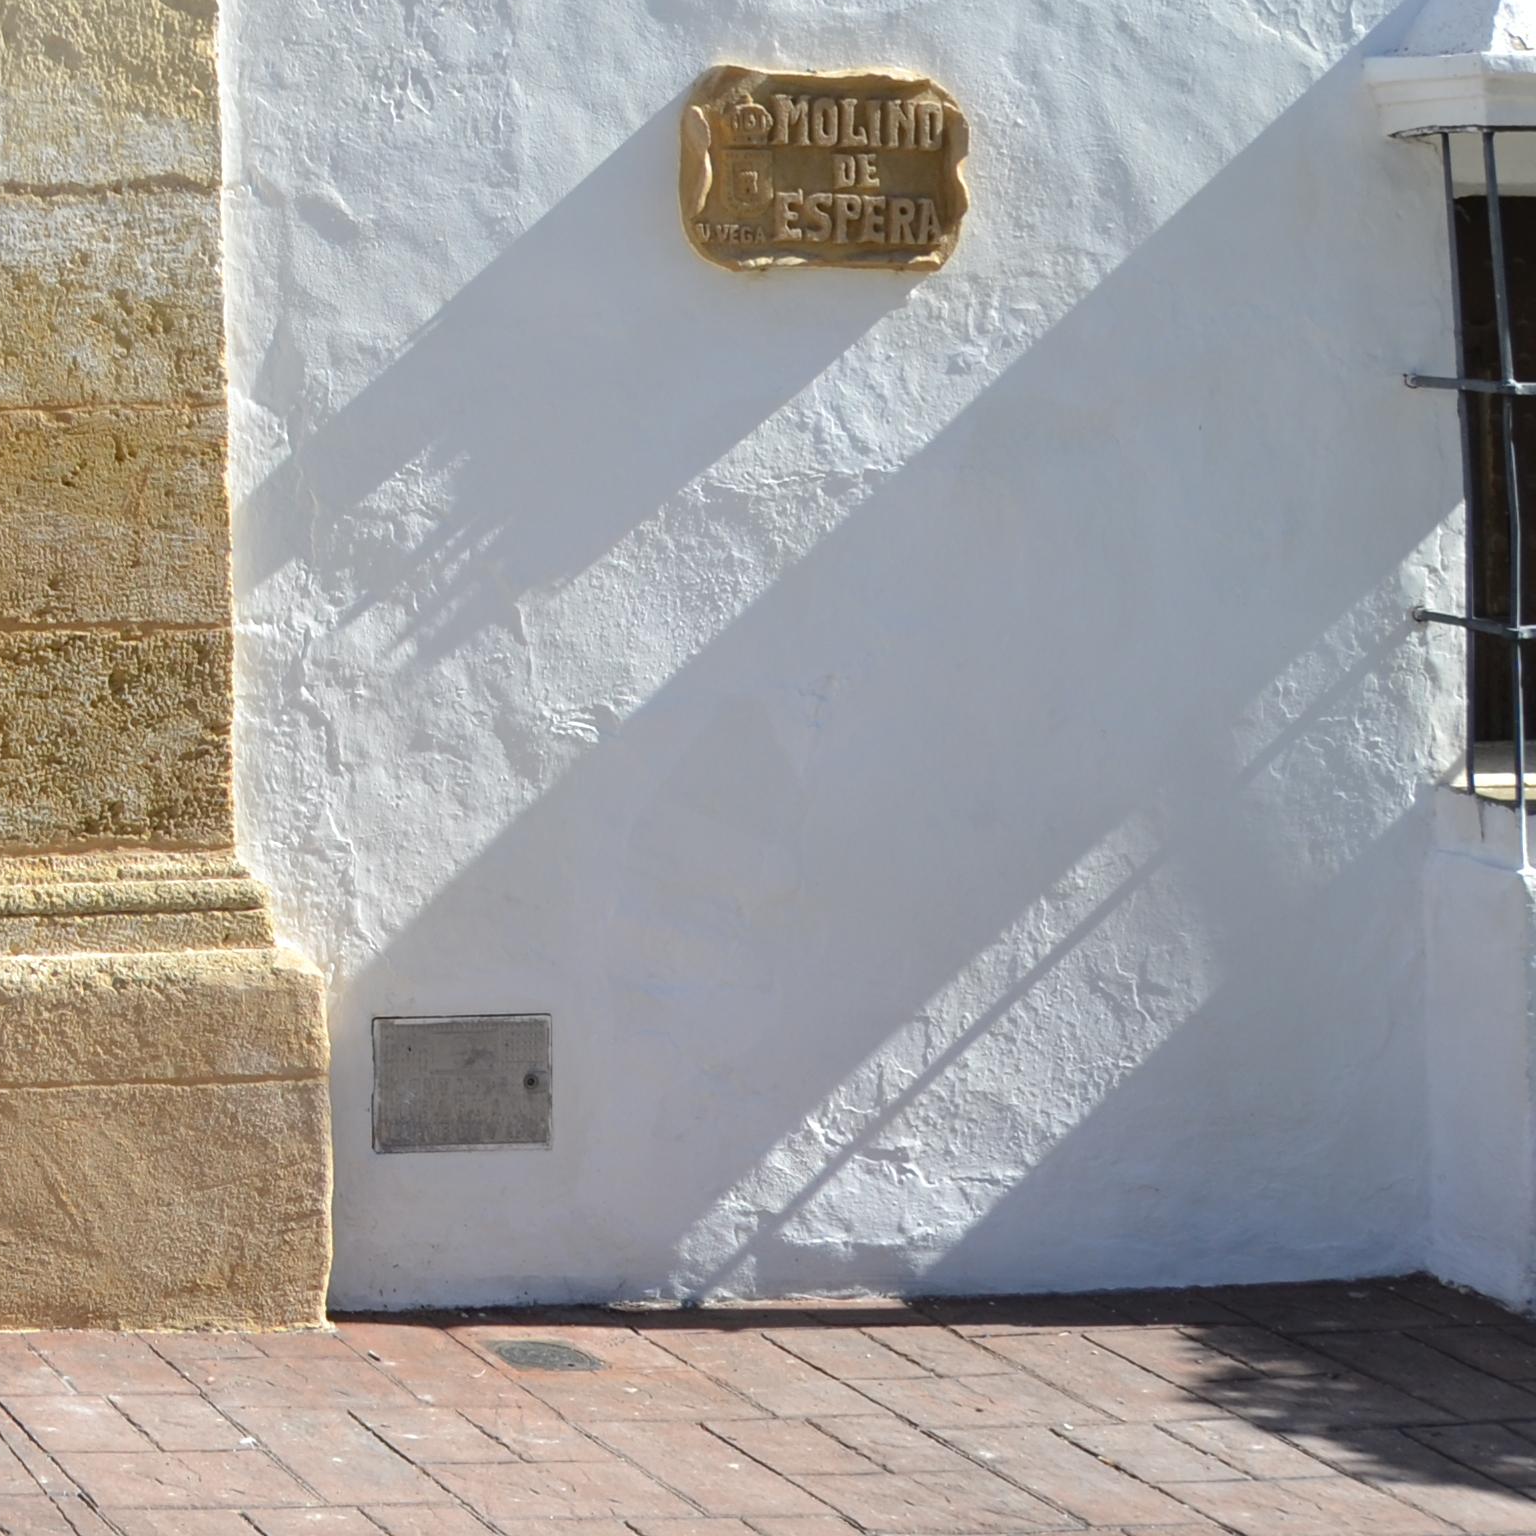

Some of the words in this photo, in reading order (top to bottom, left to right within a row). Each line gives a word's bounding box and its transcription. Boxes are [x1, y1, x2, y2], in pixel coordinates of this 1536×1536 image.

[771, 94, 944, 151] MOLINO
[832, 154, 880, 188] DE
[774, 188, 942, 245] ESPERA
